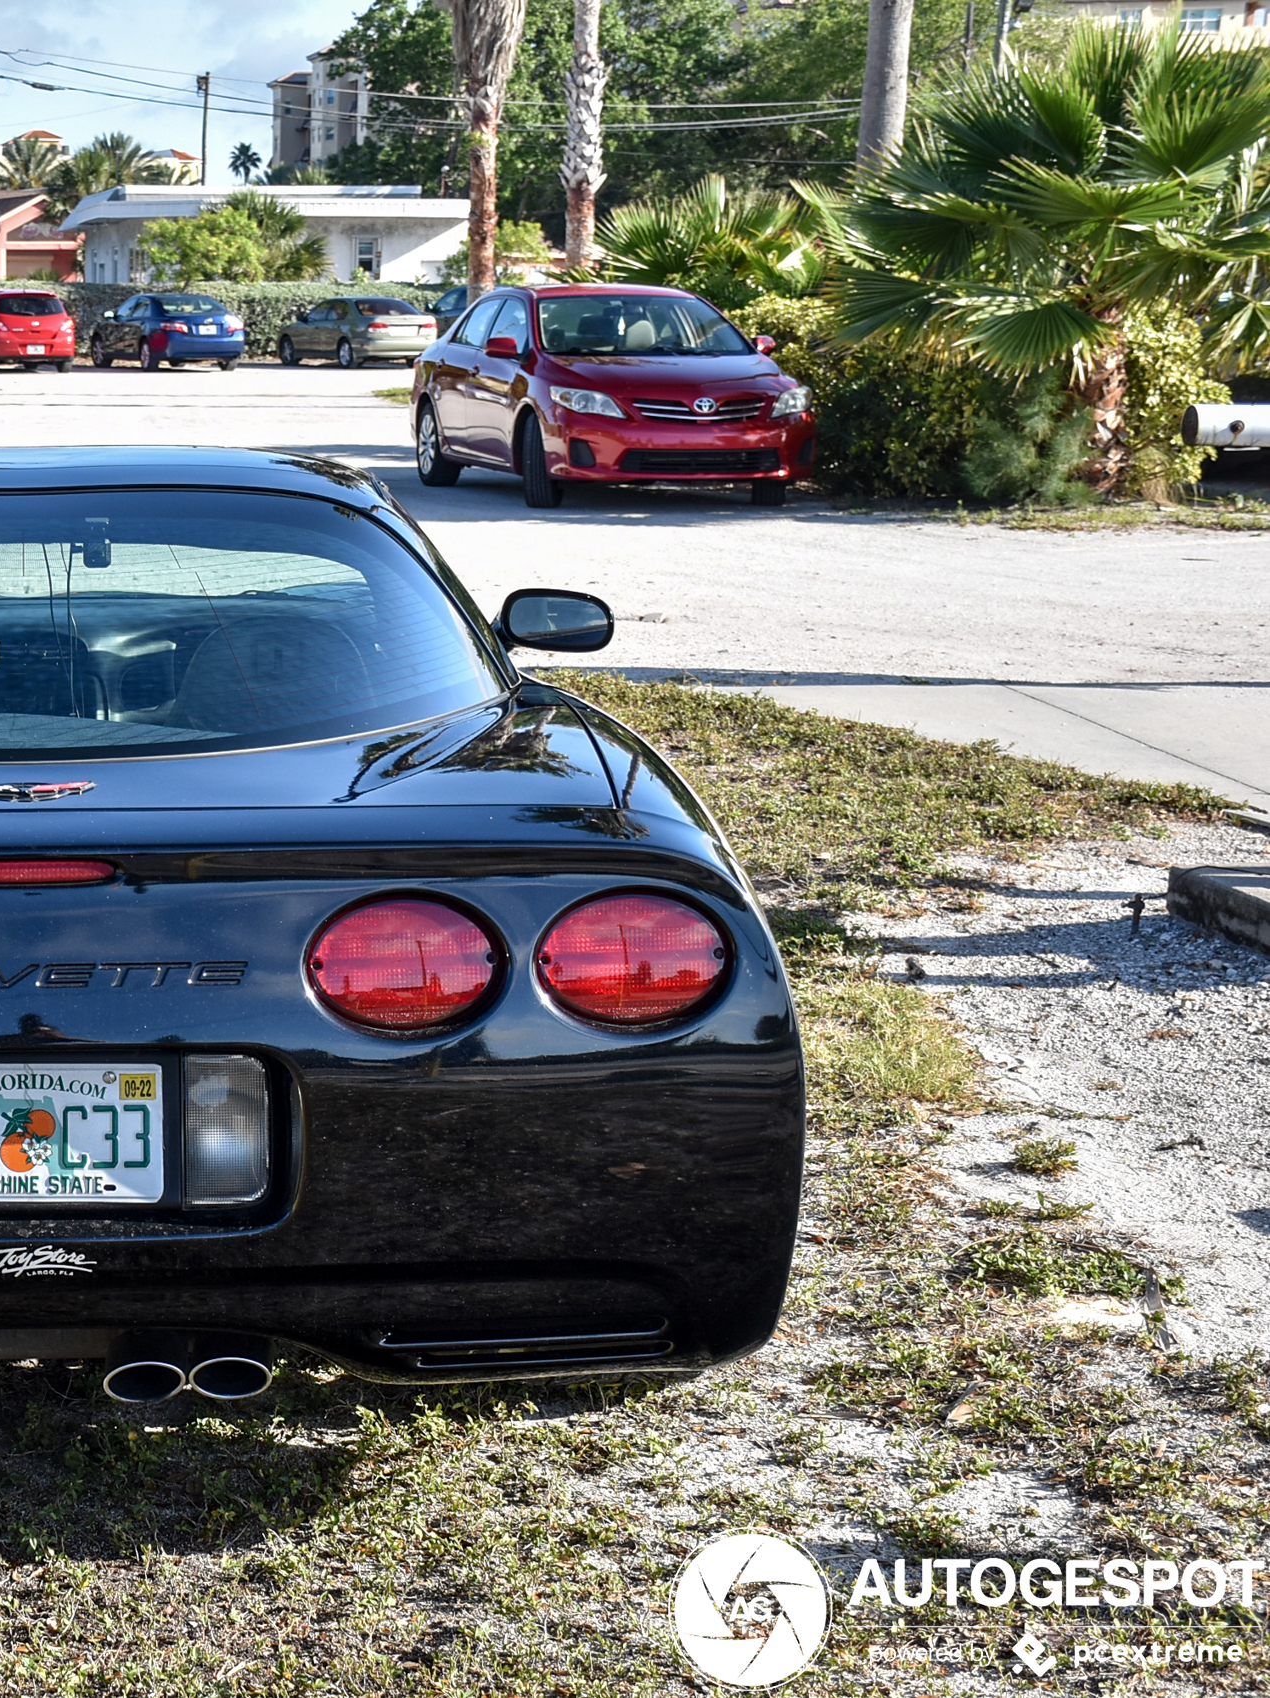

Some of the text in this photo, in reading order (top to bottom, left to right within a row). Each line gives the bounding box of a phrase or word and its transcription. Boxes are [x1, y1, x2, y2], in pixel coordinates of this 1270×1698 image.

[124, 1079, 152, 1098] 09-22
[61, 1104, 151, 1168] C33
[47, 1175, 104, 1194] STATE
[29, 1244, 98, 1268] Store
